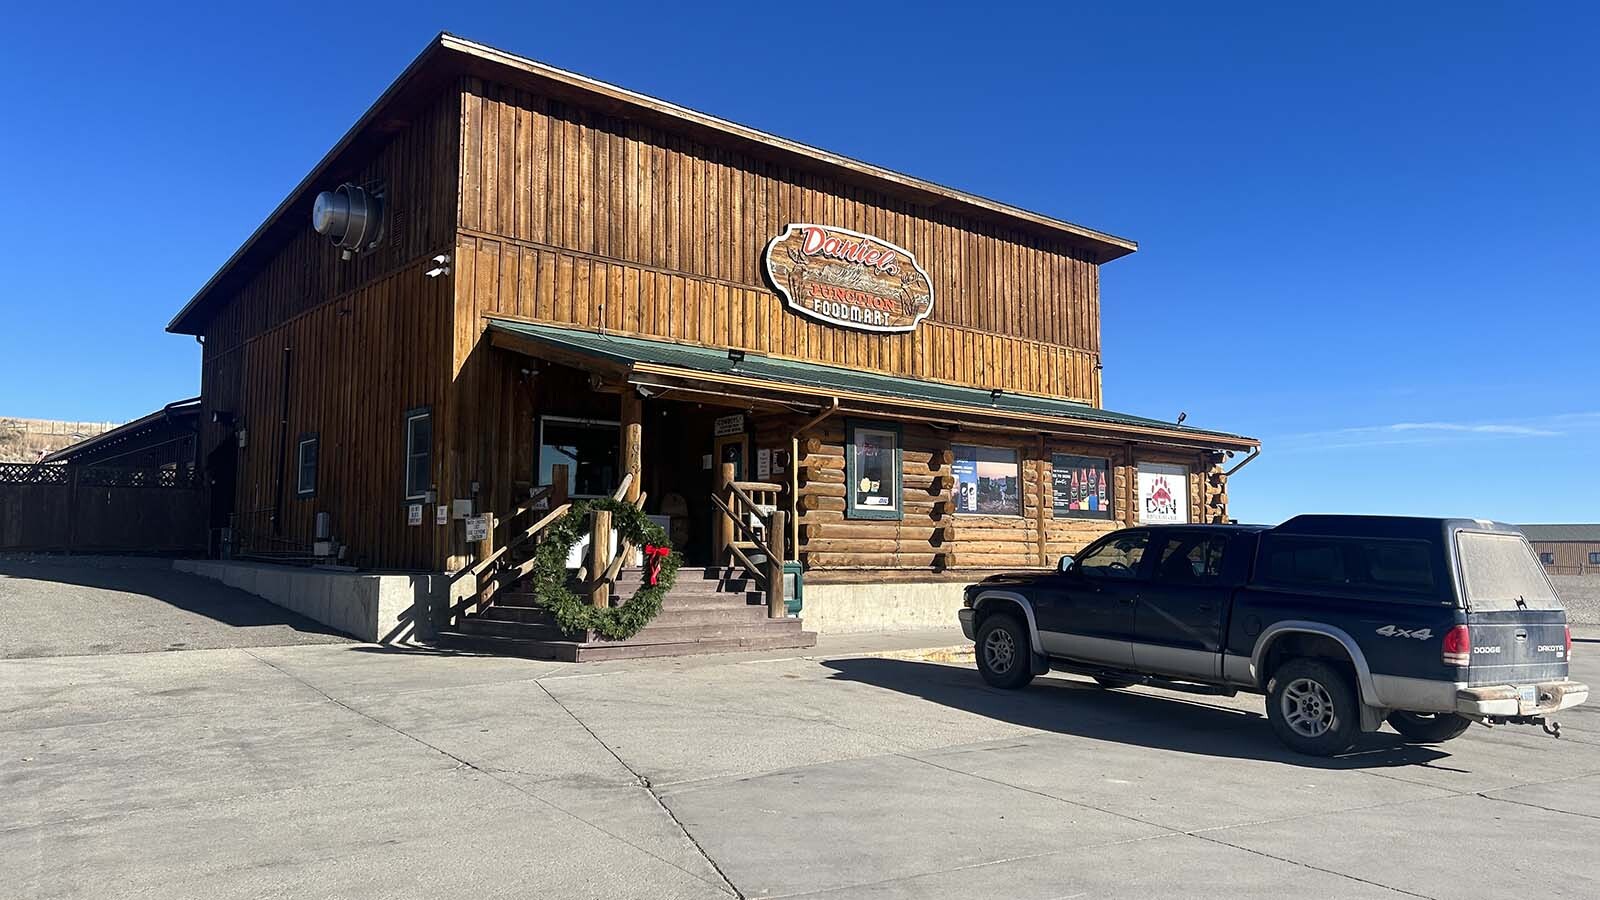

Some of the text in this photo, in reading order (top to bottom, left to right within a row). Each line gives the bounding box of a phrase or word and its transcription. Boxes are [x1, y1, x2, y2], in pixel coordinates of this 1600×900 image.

[803, 226, 899, 275] Daniels
[809, 283, 897, 312] JUNCTION
[814, 299, 890, 326] FOODMART
[1375, 625, 1435, 641] 4x4
[1473, 646, 1501, 654] DODGE
